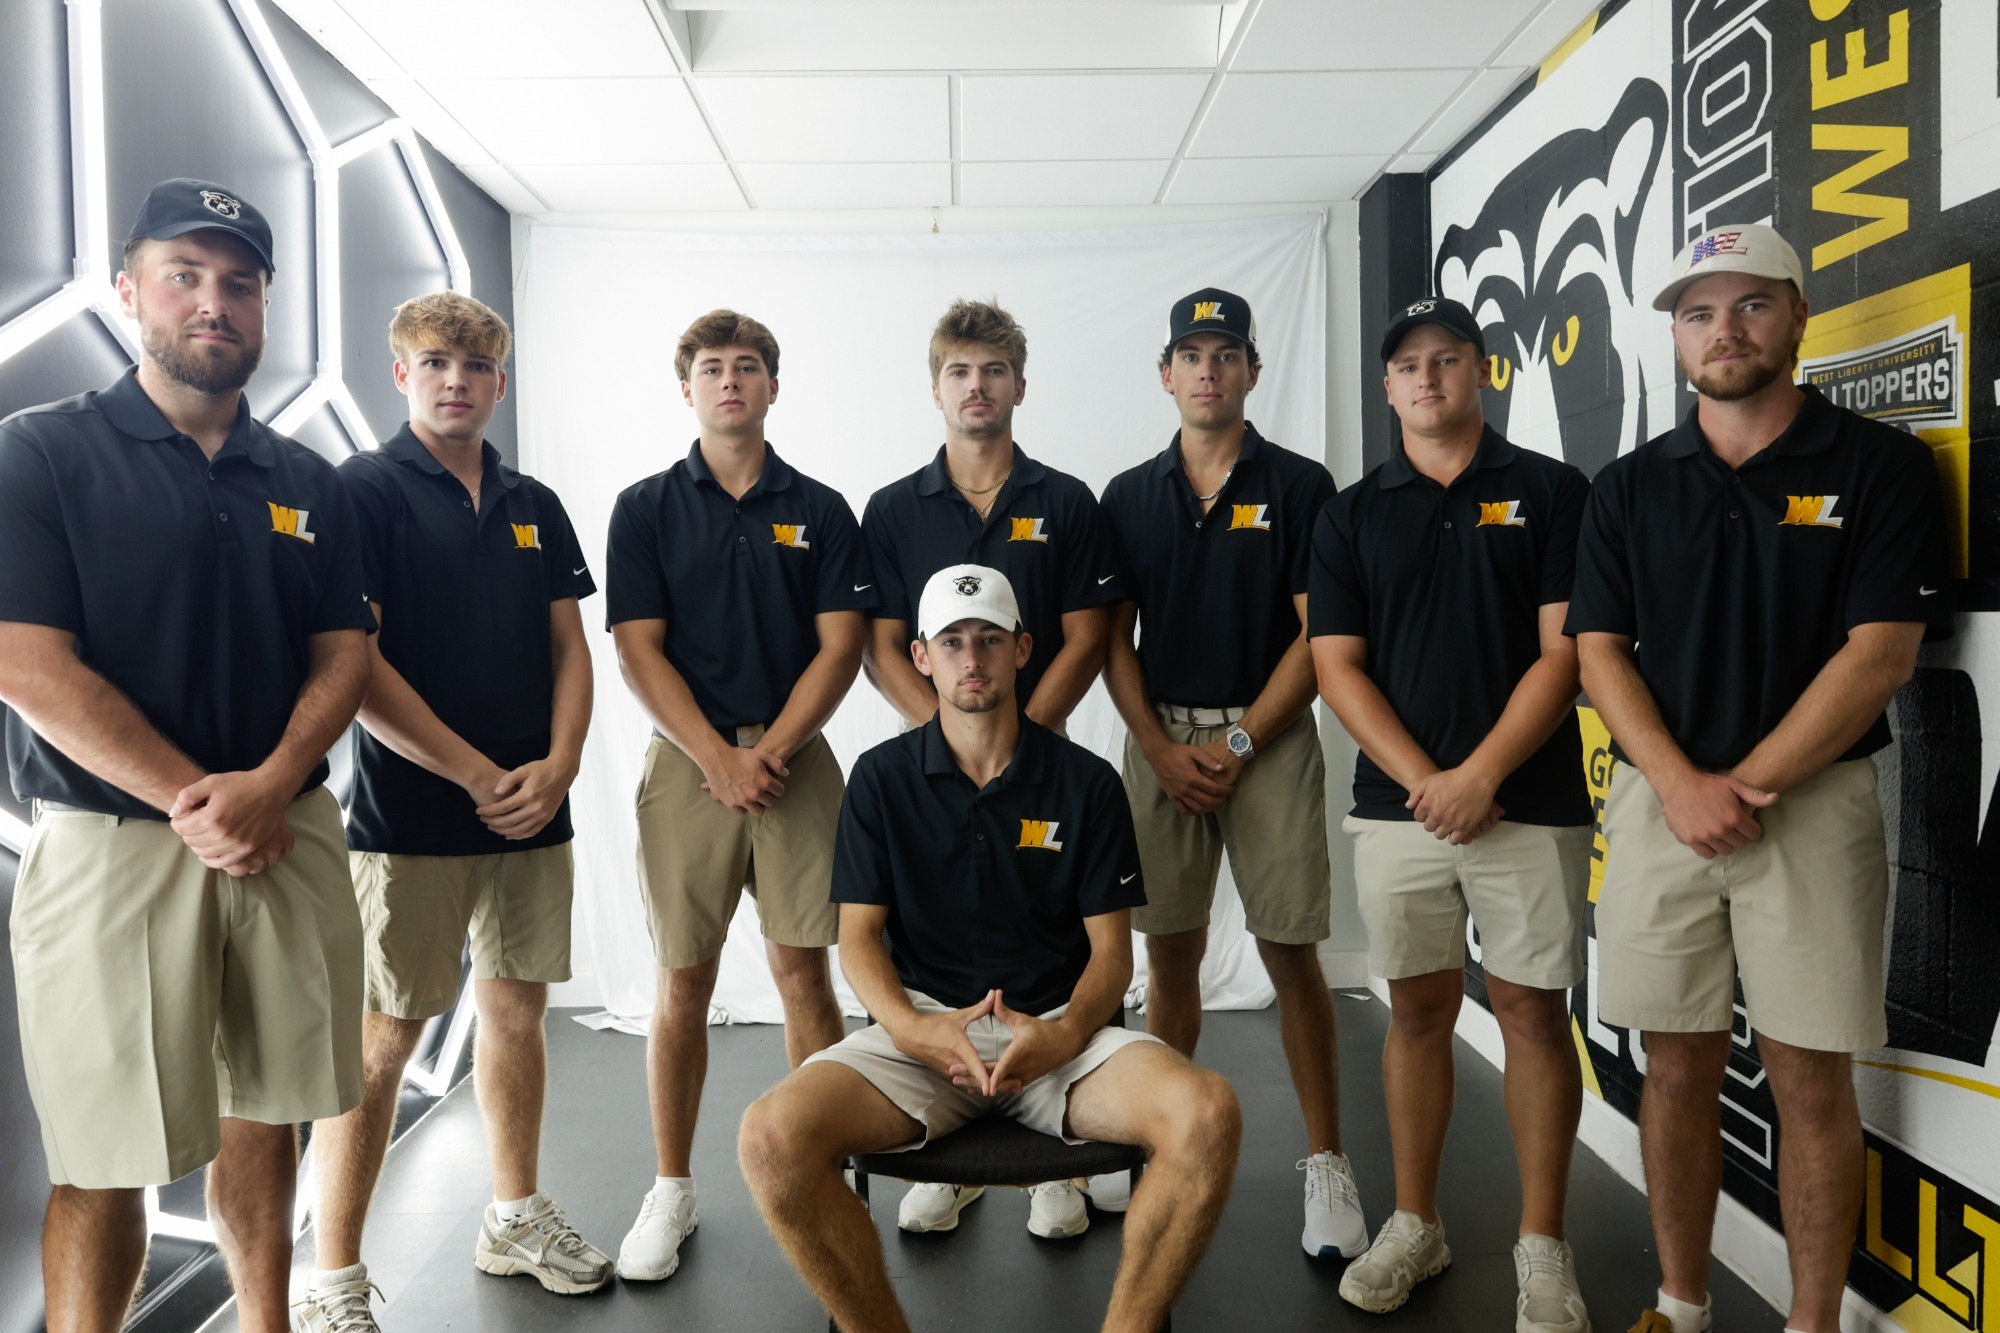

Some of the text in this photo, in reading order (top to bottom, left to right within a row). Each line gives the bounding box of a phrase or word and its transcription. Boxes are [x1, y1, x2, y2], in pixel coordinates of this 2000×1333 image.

[1194, 302, 1225, 321] WL
[1812, 342, 1937, 385] WEST LIBERTY UNIVERSITY
[267, 501, 315, 544] WL
[1231, 504, 1271, 530] WL
[1479, 500, 1526, 526] WL
[1783, 495, 1844, 528] WL
[510, 522, 541, 550] WL
[771, 523, 810, 550] WL
[1010, 517, 1048, 542] WL
[1019, 819, 1063, 851] WL
